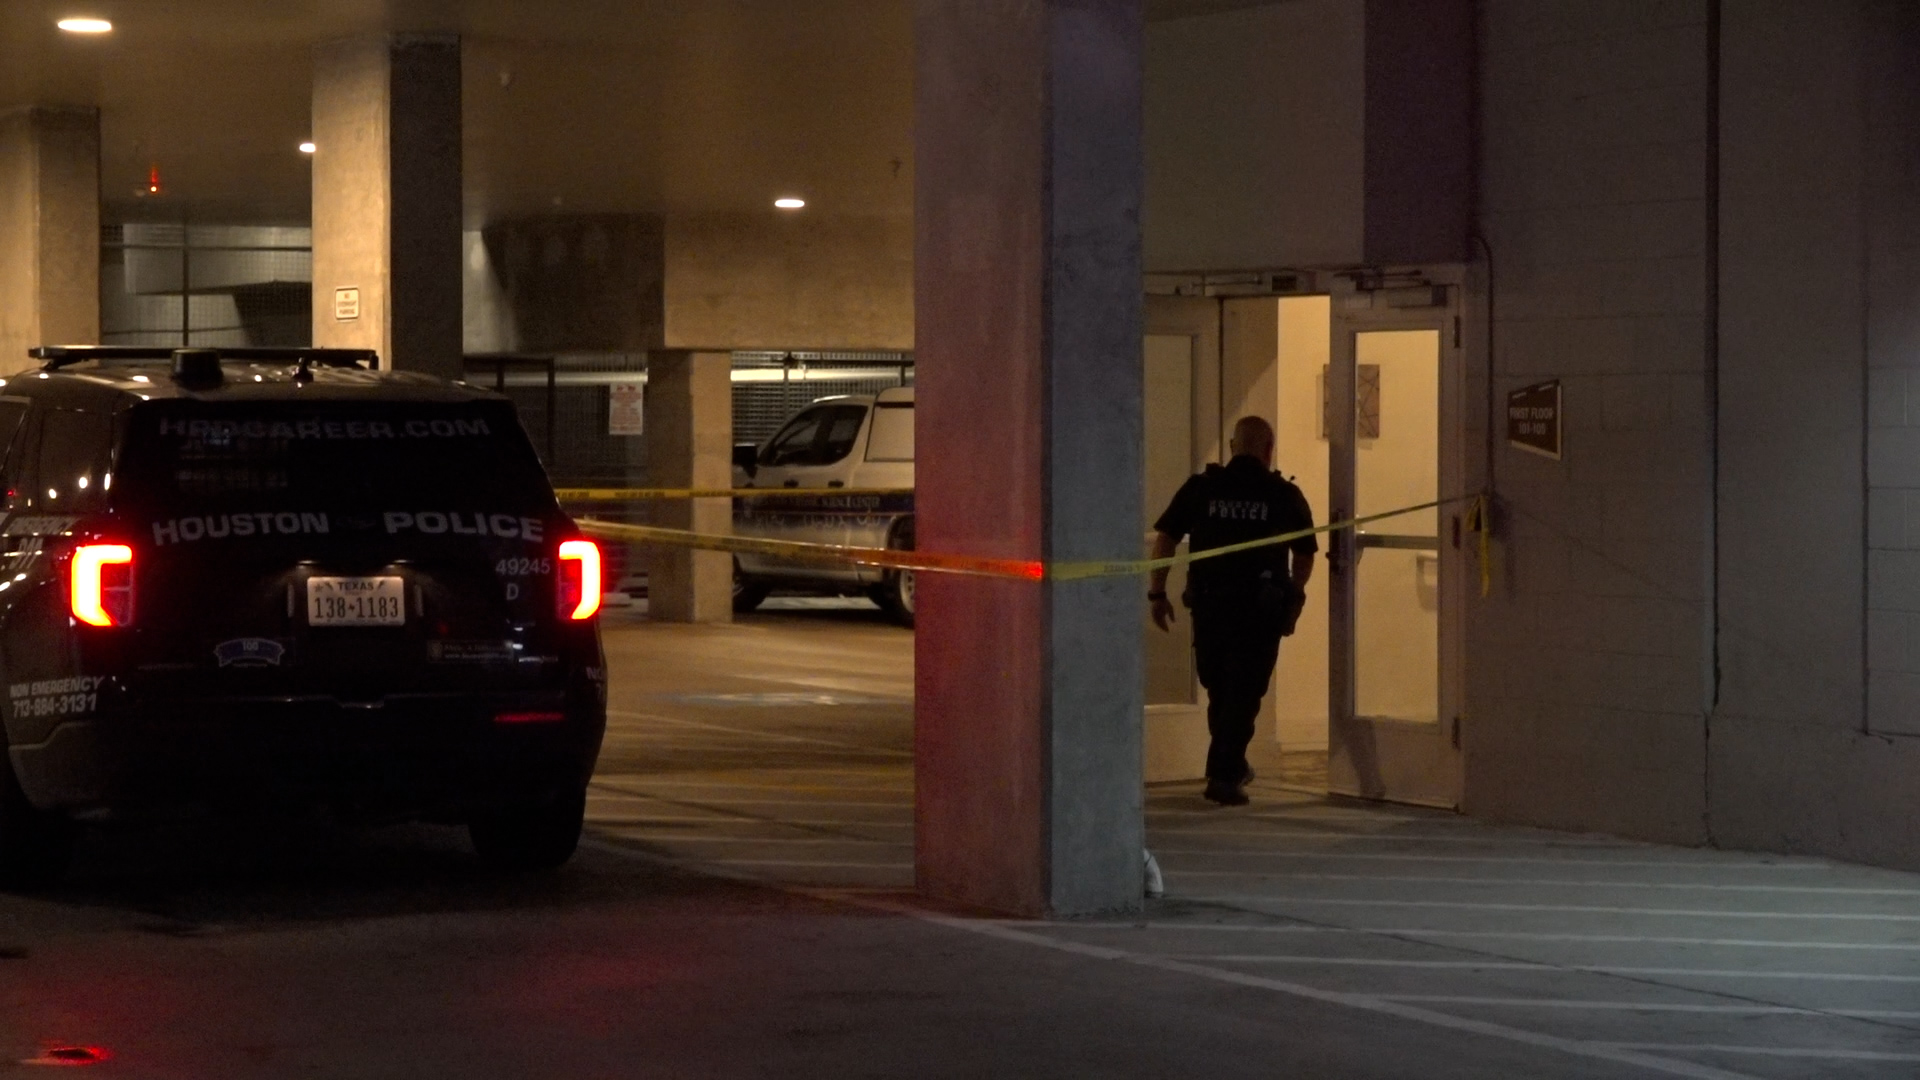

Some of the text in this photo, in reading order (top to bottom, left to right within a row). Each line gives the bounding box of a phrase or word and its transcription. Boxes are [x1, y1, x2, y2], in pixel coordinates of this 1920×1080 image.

[1209, 506, 1268, 521] POLICE
[152, 511, 544, 547] HOUSTON POLICE
[495, 556, 551, 575] 49245
[337, 581, 374, 591] TEXAS
[506, 583, 519, 601] D
[31, 675, 105, 696] EMERGENCY
[13, 692, 97, 719] 713-884-3131
